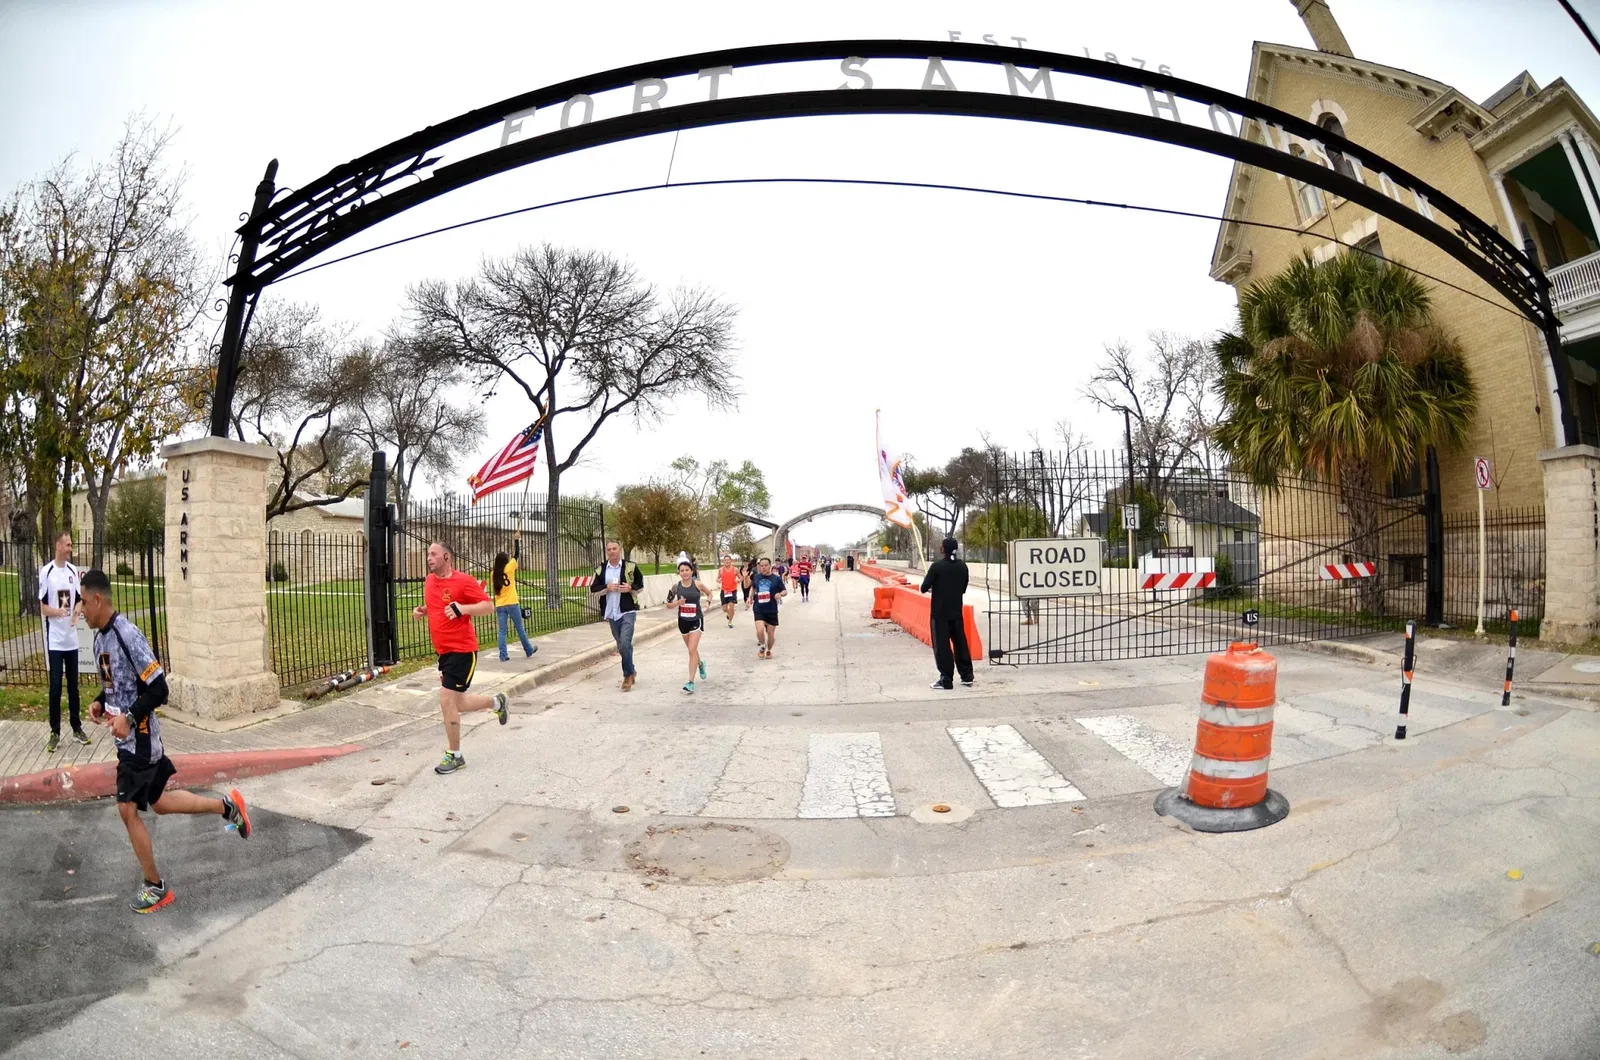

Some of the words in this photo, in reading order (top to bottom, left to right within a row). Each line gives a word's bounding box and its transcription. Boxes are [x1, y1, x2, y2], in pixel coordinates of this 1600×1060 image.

[500, 65, 734, 147] FORT
[836, 55, 1055, 101] SAM
[1142, 85, 1434, 222] HOUSTON
[181, 469, 190, 502] US
[180, 512, 188, 581] ARMY
[1030, 547, 1086, 564] ROAD
[1020, 570, 1097, 588] CLOSED
[1246, 612, 1258, 623] US
